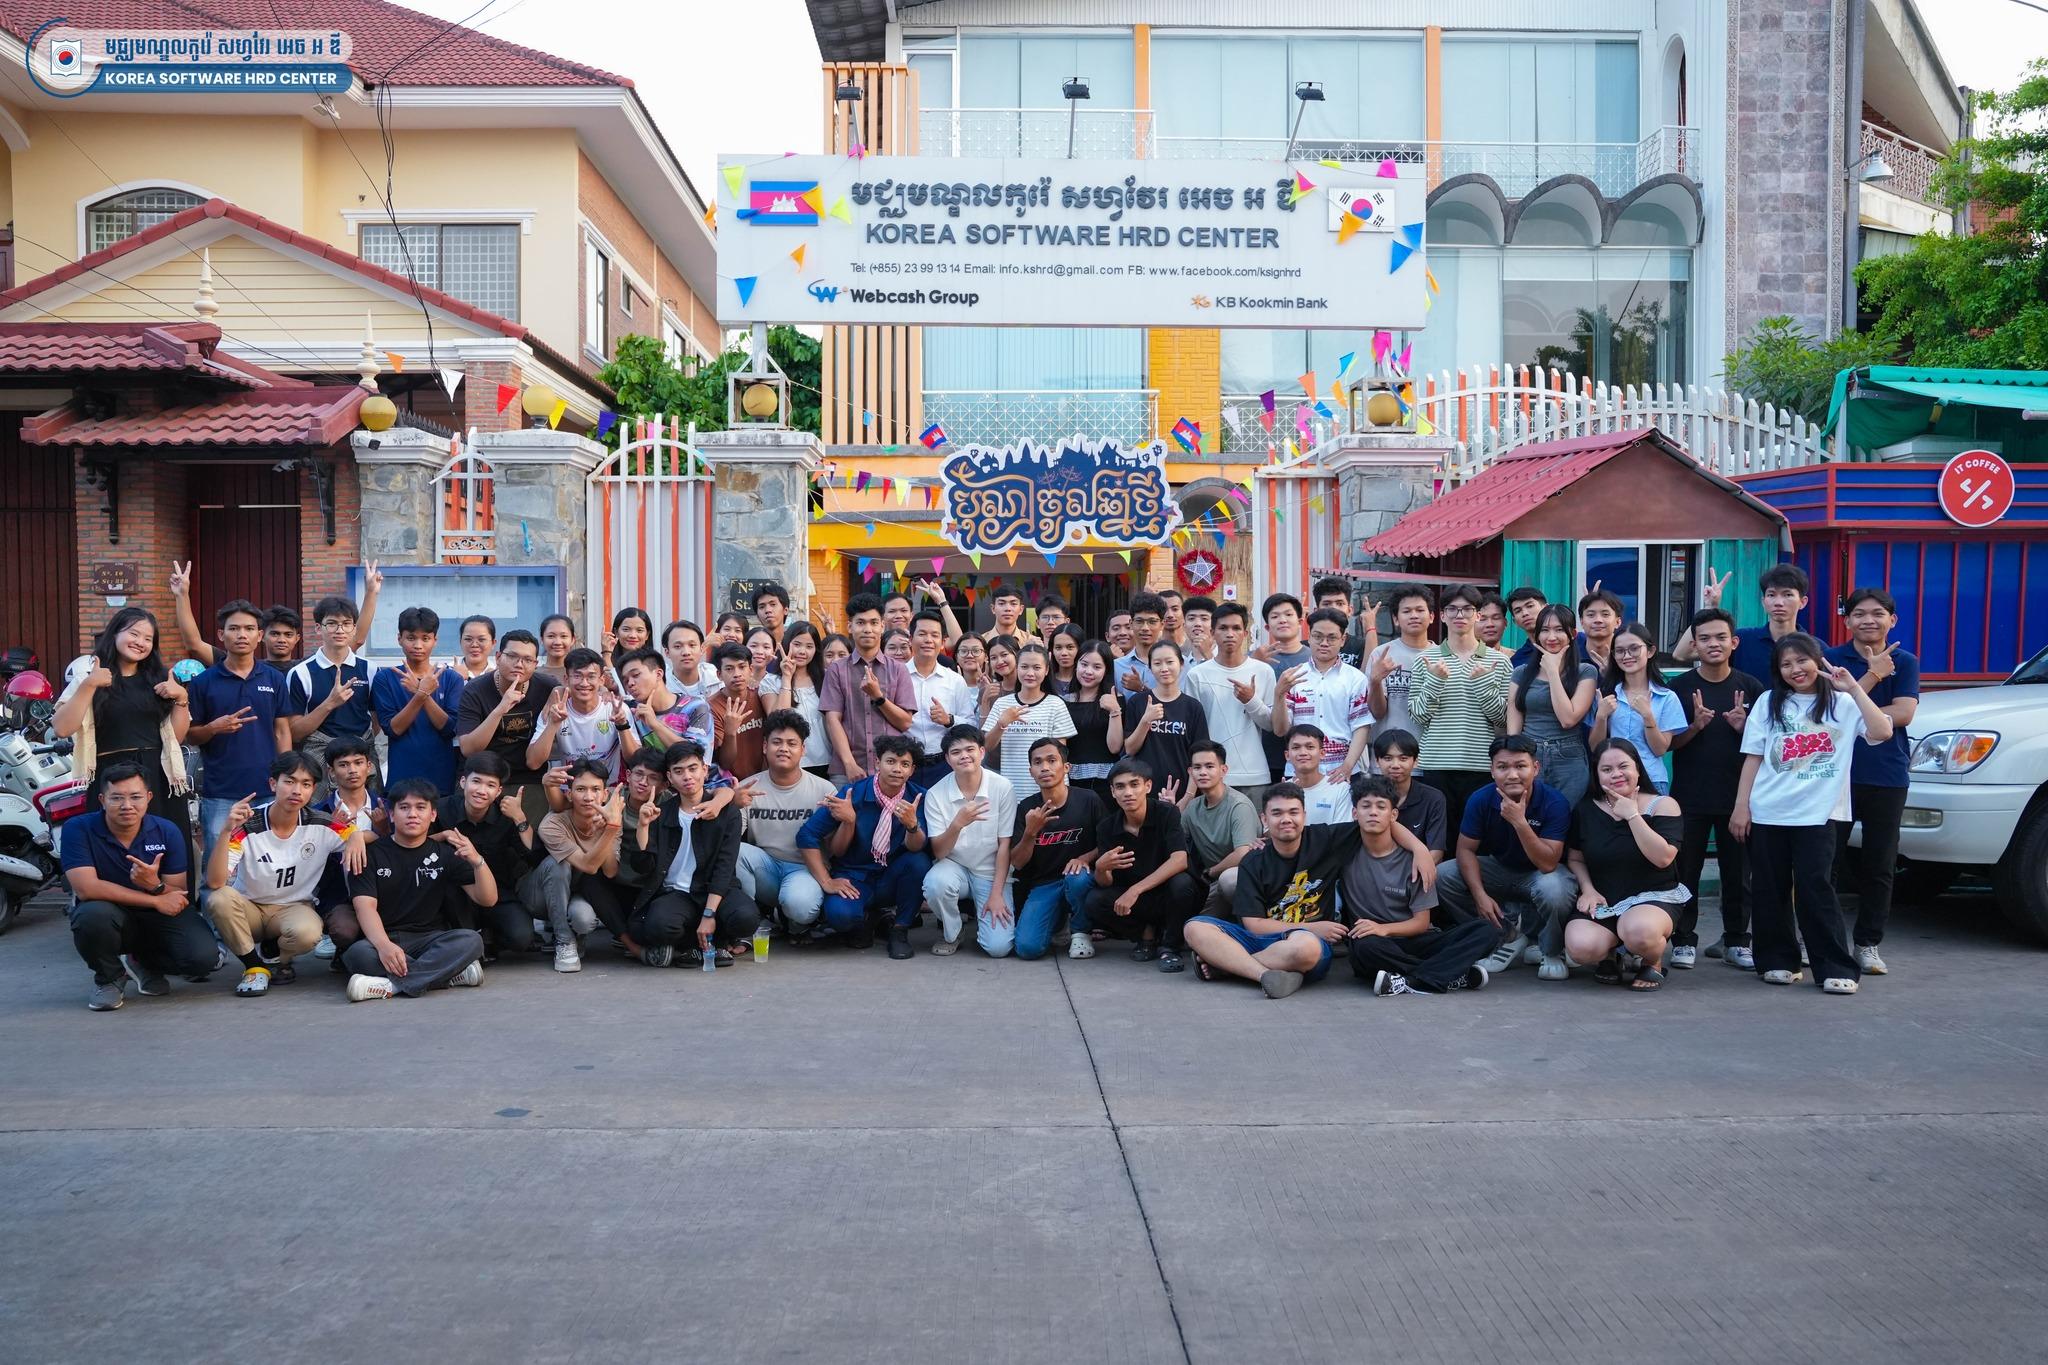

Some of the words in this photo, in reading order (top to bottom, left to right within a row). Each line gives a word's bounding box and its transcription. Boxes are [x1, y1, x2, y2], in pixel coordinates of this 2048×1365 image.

[866, 222, 957, 245] KOREA
[966, 223, 1111, 246] SOFTWARE
[1118, 225, 1171, 247] HRD
[1177, 226, 1280, 249] CENTER
[850, 262, 867, 274] Tel:
[869, 262, 901, 276] (+855)
[904, 263, 918, 273] 23
[920, 263, 934, 273] 99
[936, 263, 947, 273] 13
[949, 263, 961, 273] 14
[964, 263, 996, 275] Email:
[1127, 265, 1146, 275] FB:
[850, 289, 926, 304] Webcash
[928, 289, 980, 308] Group
[1215, 296, 1236, 308] KB
[1238, 296, 1294, 309] Kookmin
[1296, 297, 1328, 309] Bank
[1954, 464, 1964, 475] IT
[1965, 459, 2001, 475] COFFEE
[735, 599, 751, 610] St.
[257, 685, 274, 693] KSGA
[1809, 763, 1835, 771] more
[1797, 770, 1835, 780] harvest
[275, 865, 297, 888] 18
